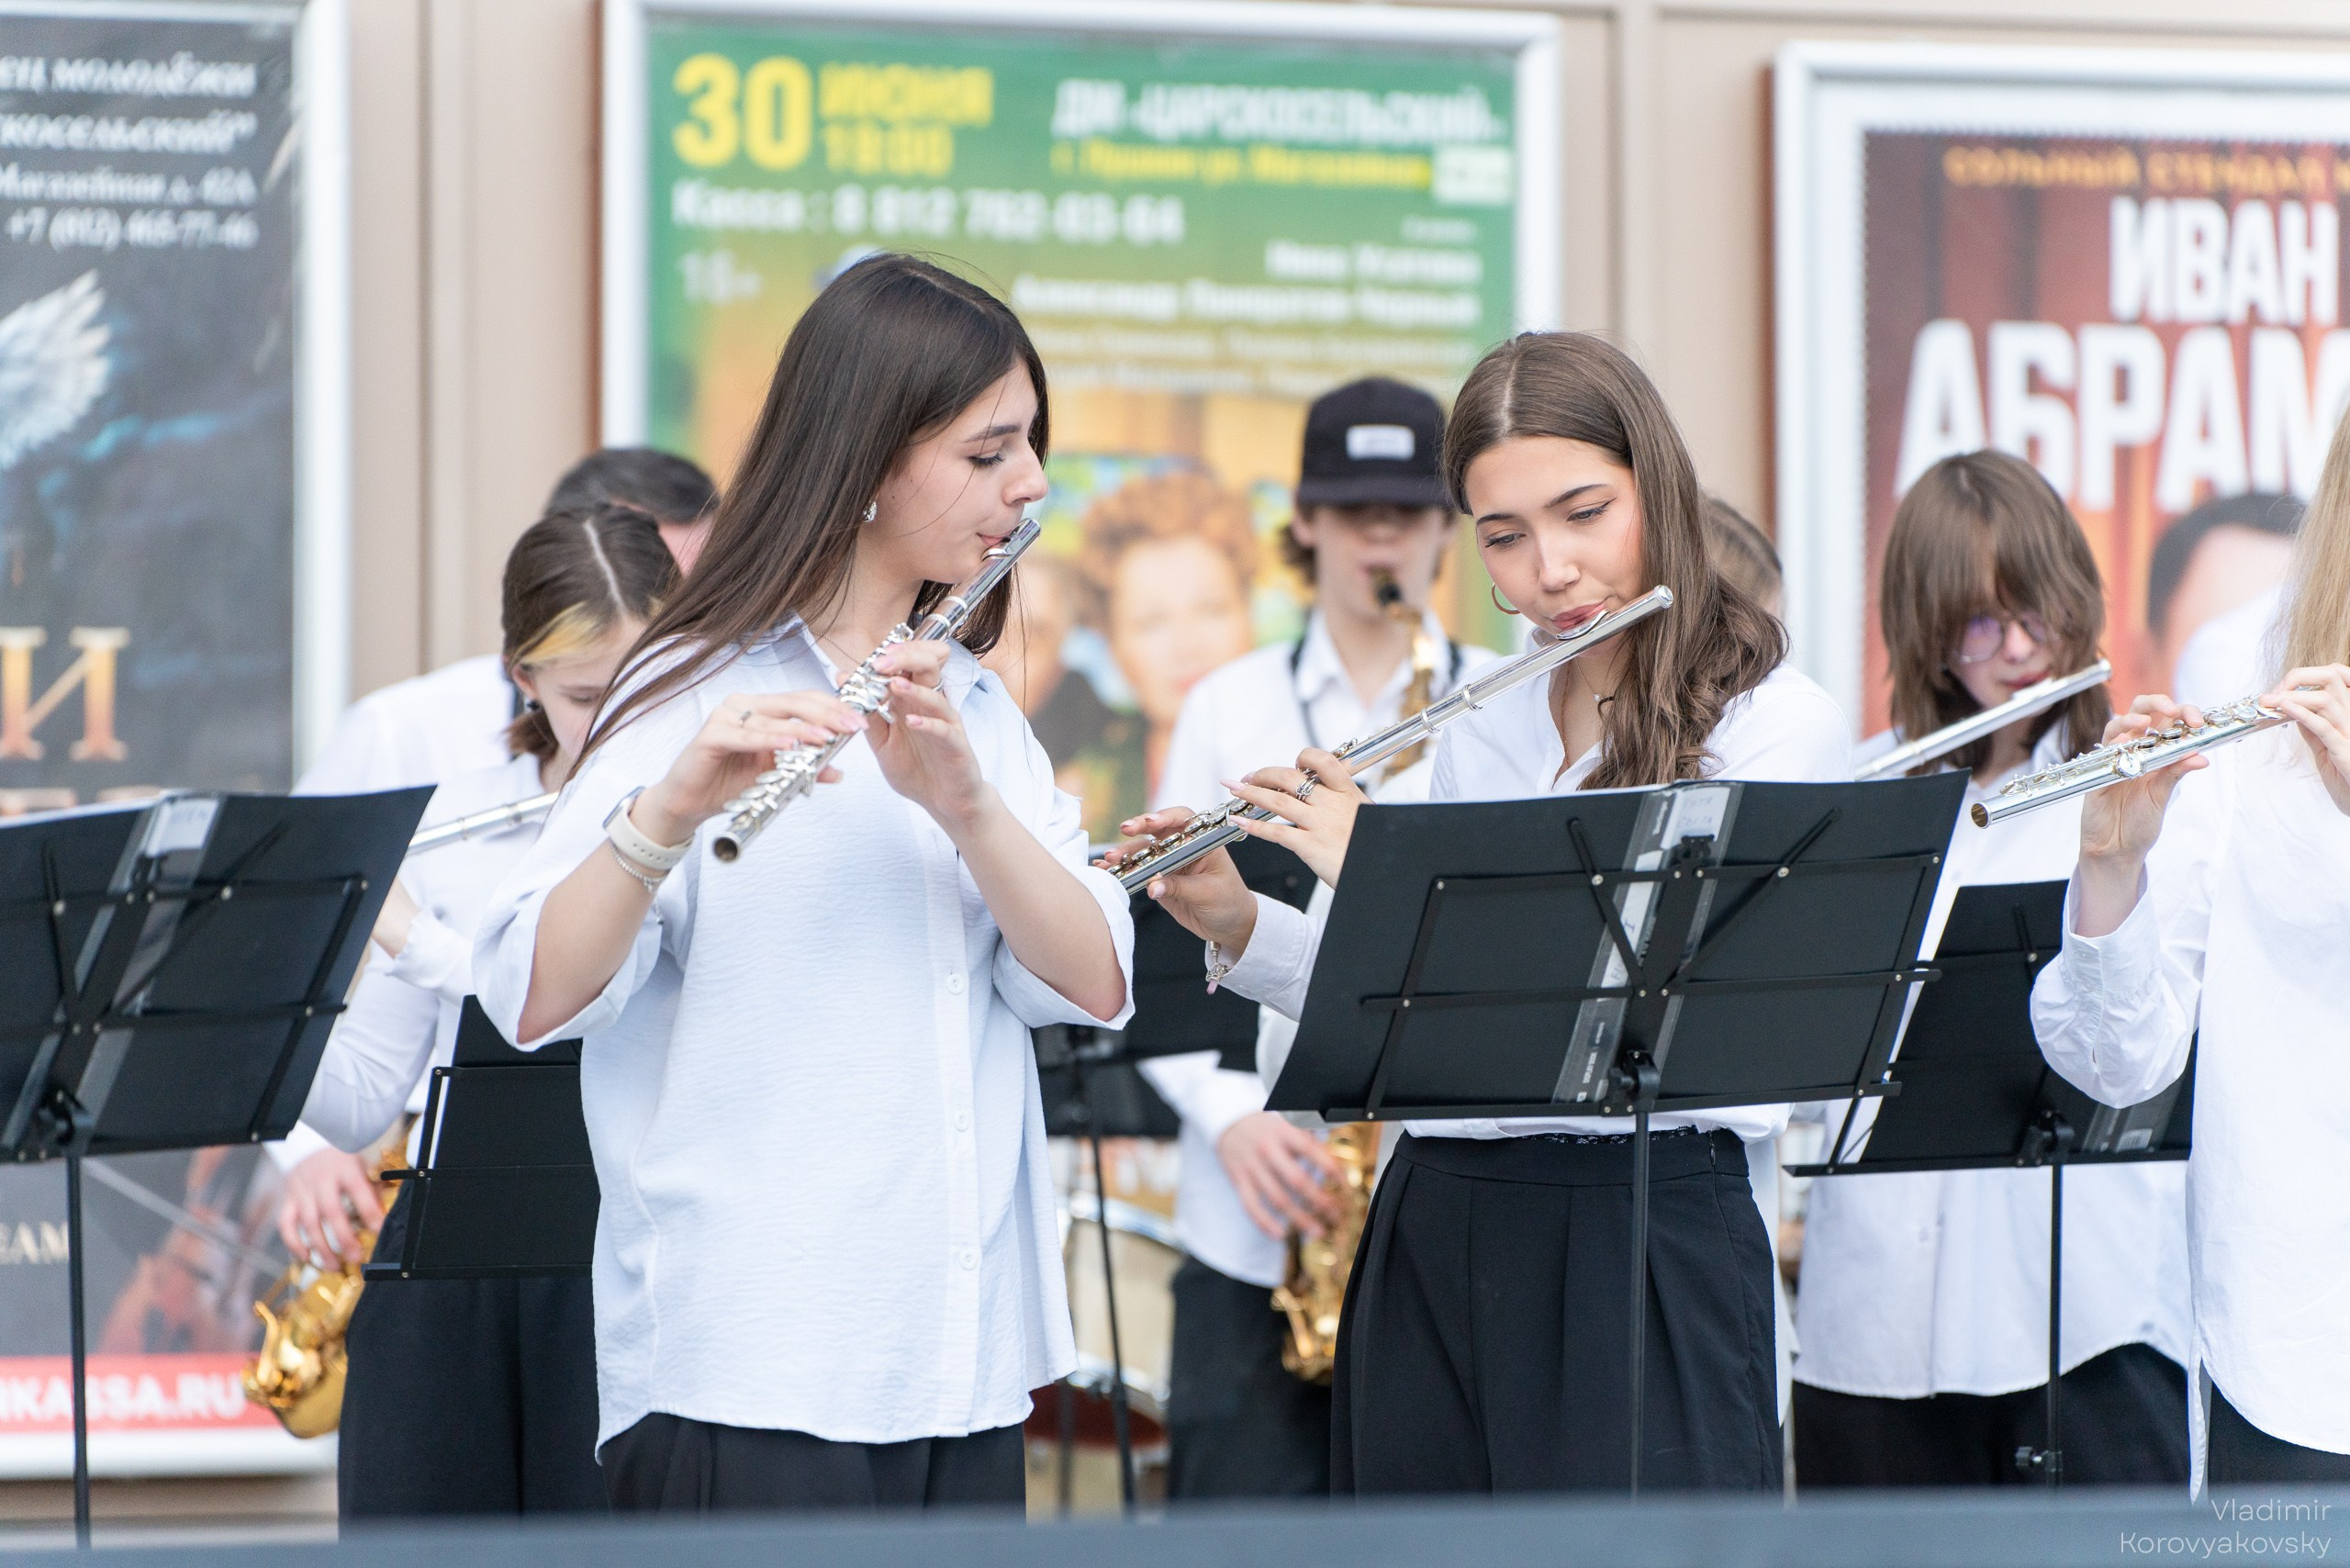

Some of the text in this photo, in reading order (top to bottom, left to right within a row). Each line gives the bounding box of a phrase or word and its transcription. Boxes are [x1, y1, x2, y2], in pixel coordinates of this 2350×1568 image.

[51, 50, 257, 98] МОЛОДЁЖИ
[821, 65, 991, 125] ИЮНЯ
[672, 52, 813, 173] 30
[1942, 147, 2138, 187] СОЛЬНЫЙ
[2145, 153, 2330, 194] СТЕНДАП
[7, 206, 48, 245] +7
[49, 207, 122, 254] (812)
[674, 182, 803, 230] Касса
[832, 185, 866, 233] 8
[874, 186, 955, 236] 812
[2111, 196, 2339, 324] ИВАН
